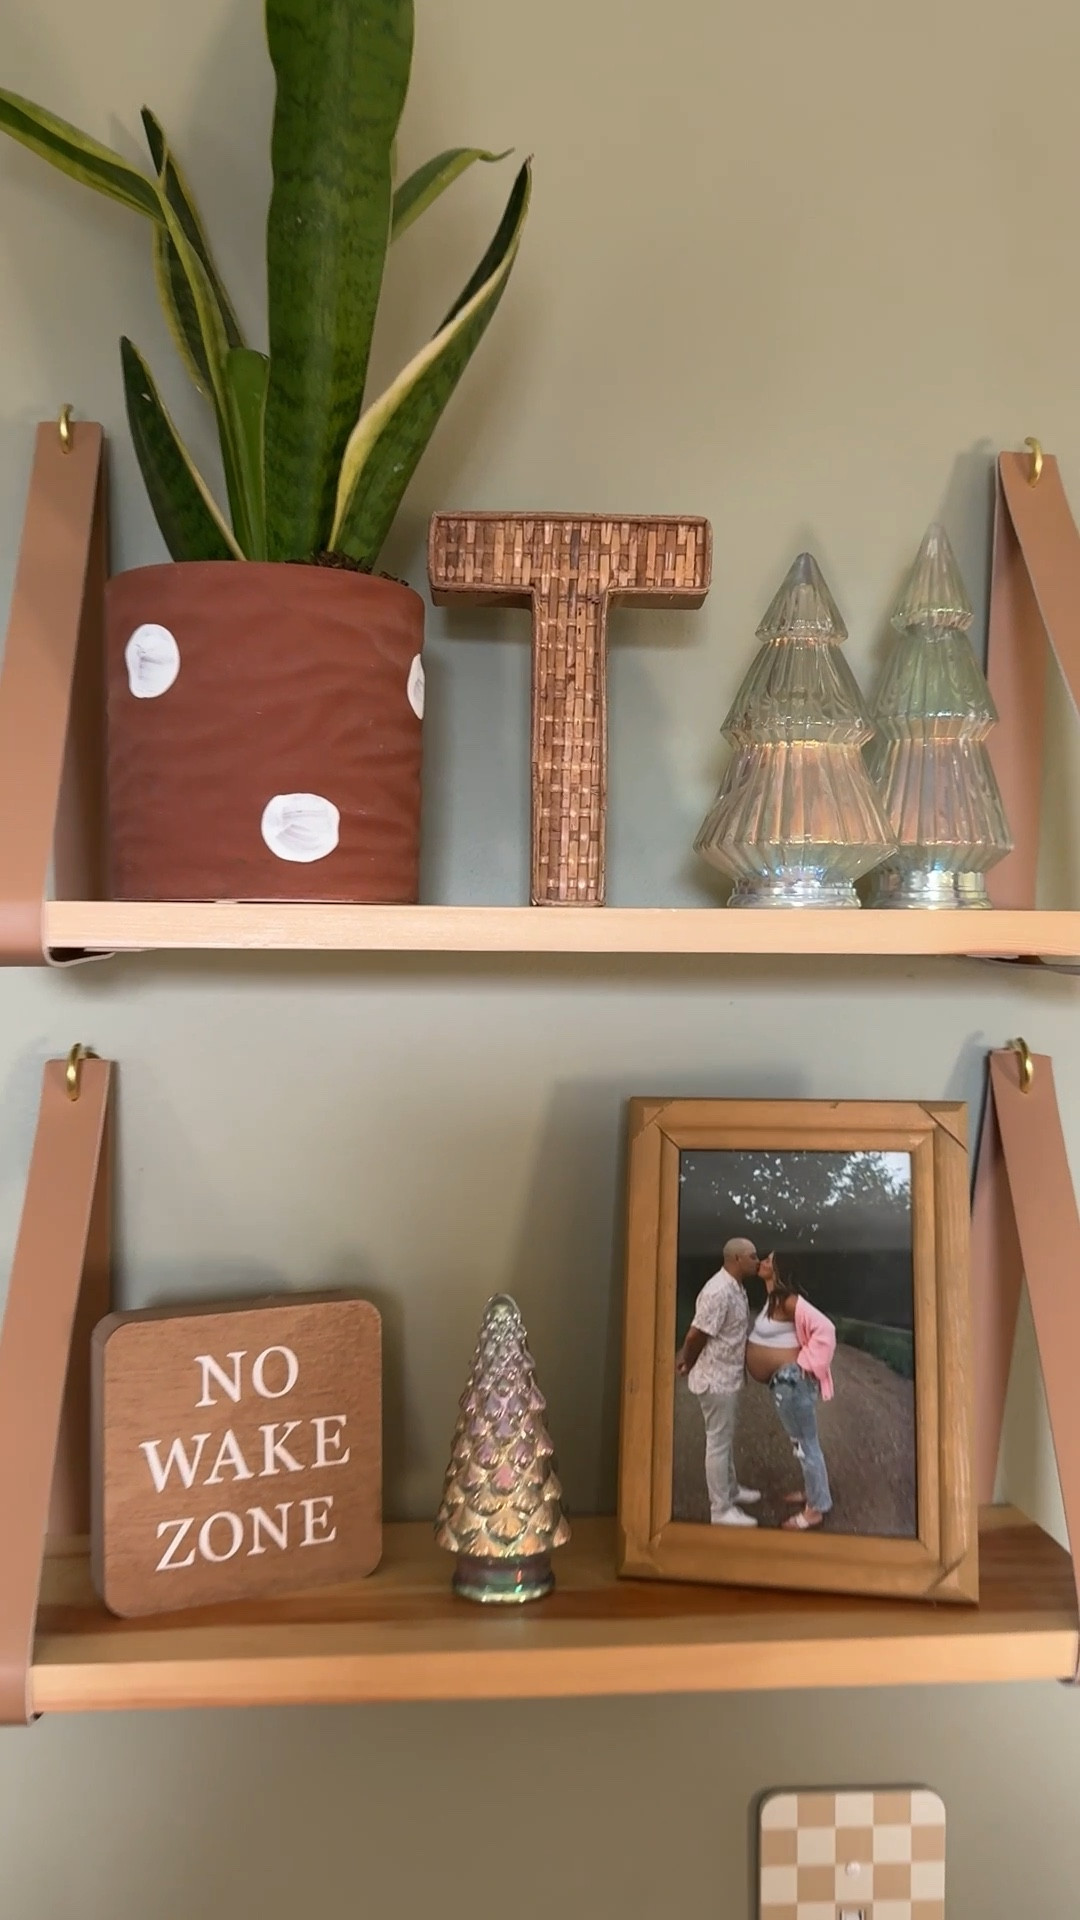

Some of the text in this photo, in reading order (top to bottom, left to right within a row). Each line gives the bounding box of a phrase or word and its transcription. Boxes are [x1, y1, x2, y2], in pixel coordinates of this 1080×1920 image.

[428, 511, 712, 907] T
[194, 1345, 299, 1407] NO
[138, 1414, 350, 1493] WAKE
[155, 1495, 337, 1572] ZONE
